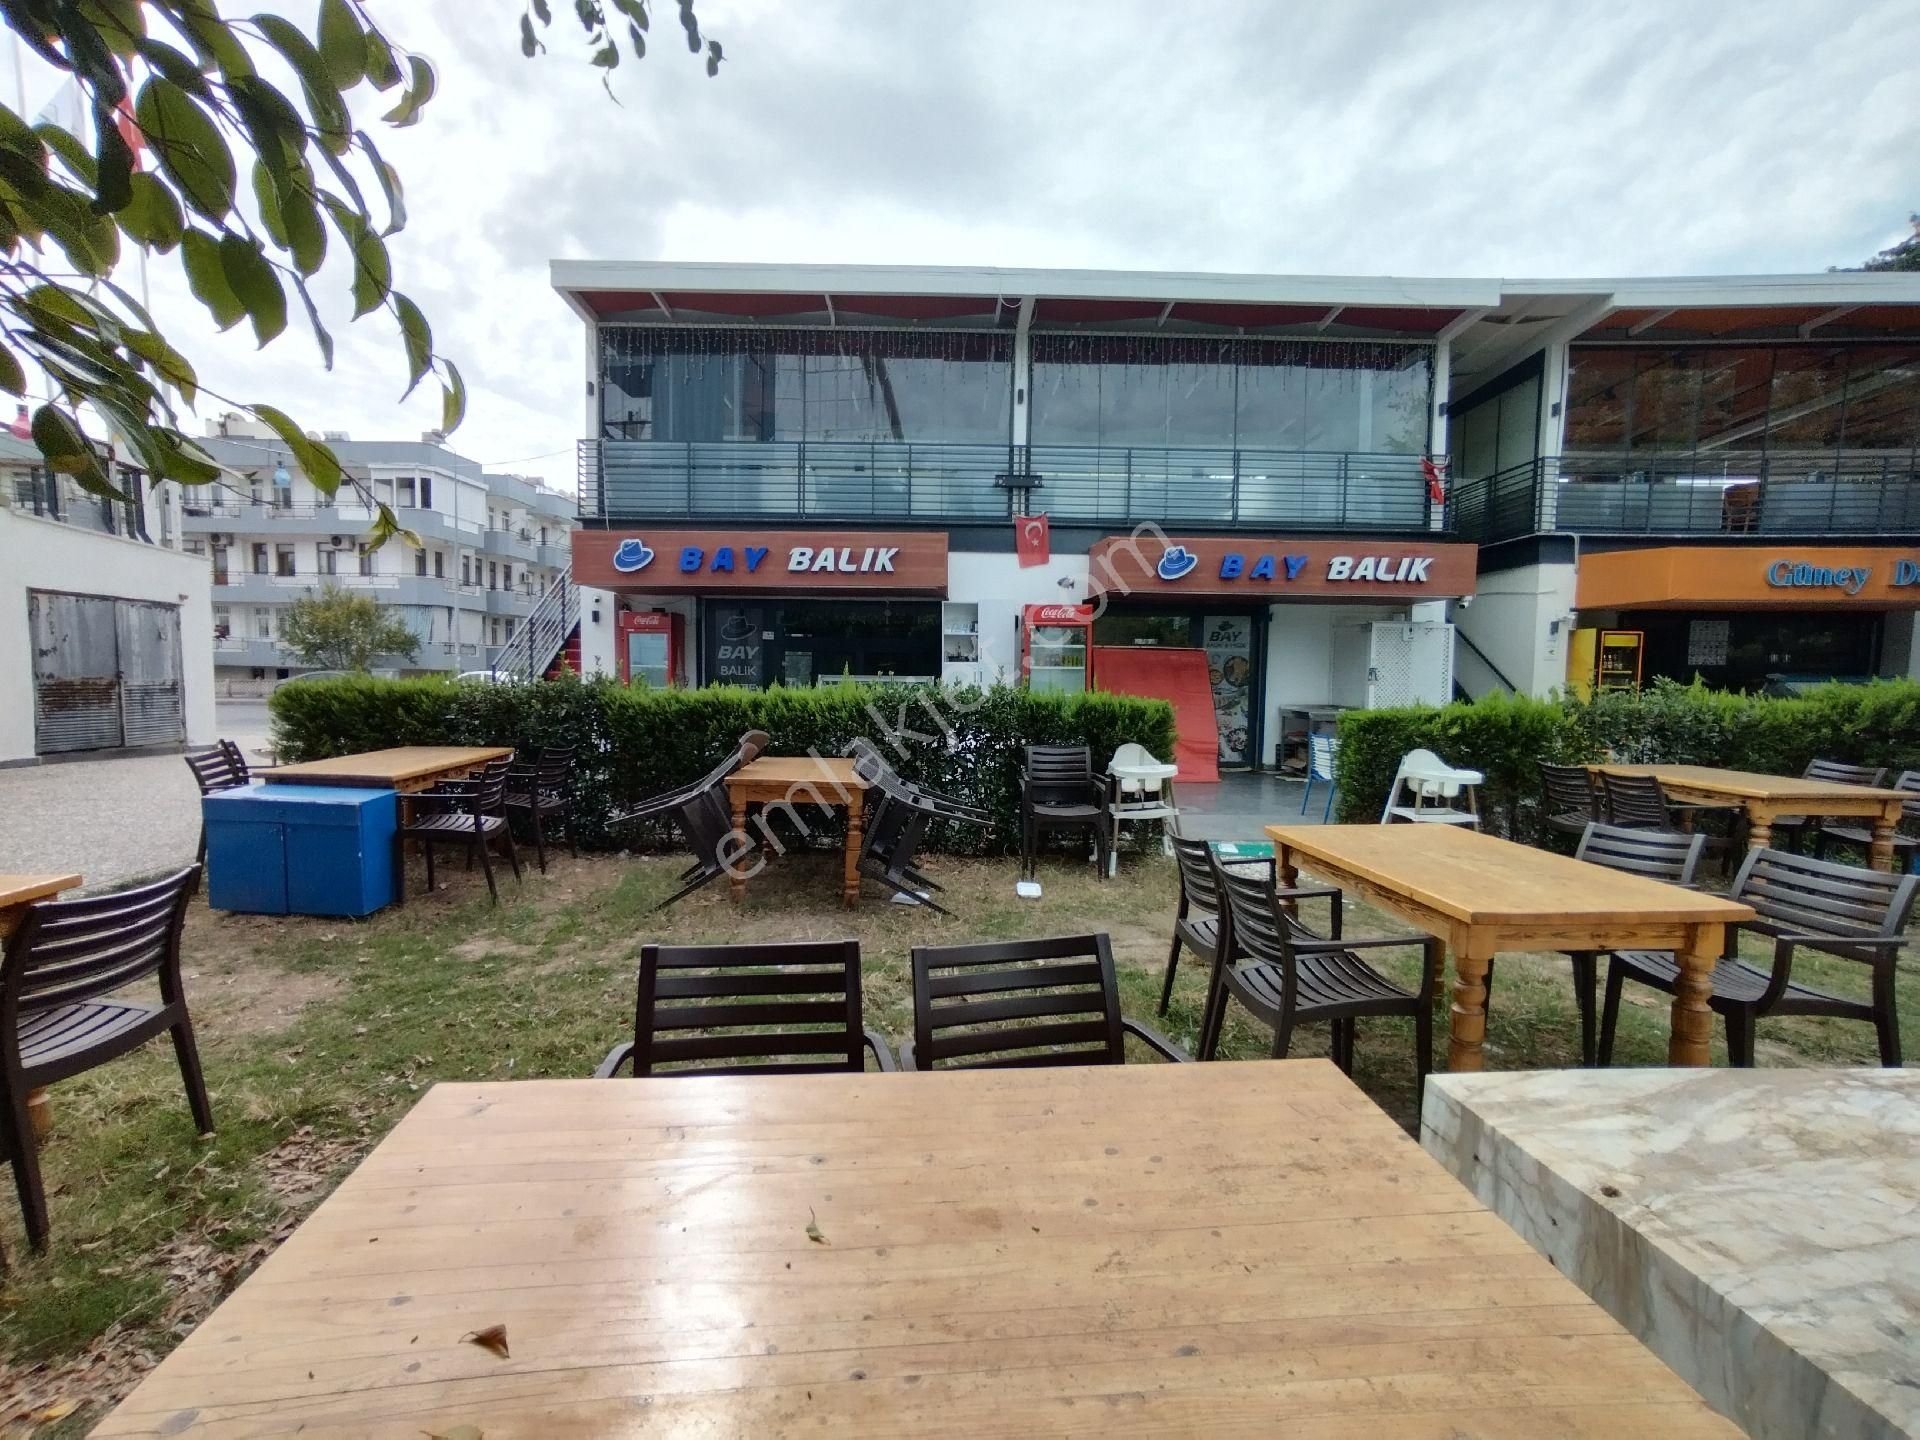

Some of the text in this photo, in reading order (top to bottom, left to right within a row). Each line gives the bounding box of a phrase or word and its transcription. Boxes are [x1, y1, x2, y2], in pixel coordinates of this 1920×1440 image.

[678, 546, 899, 574] BAY BALIK
[1219, 554, 1433, 582] BAY BALIK
[1767, 559, 1920, 595] Güney D
[1209, 631, 1242, 643] BAY
[718, 645, 760, 660] BAY
[720, 665, 757, 676] BALIK
